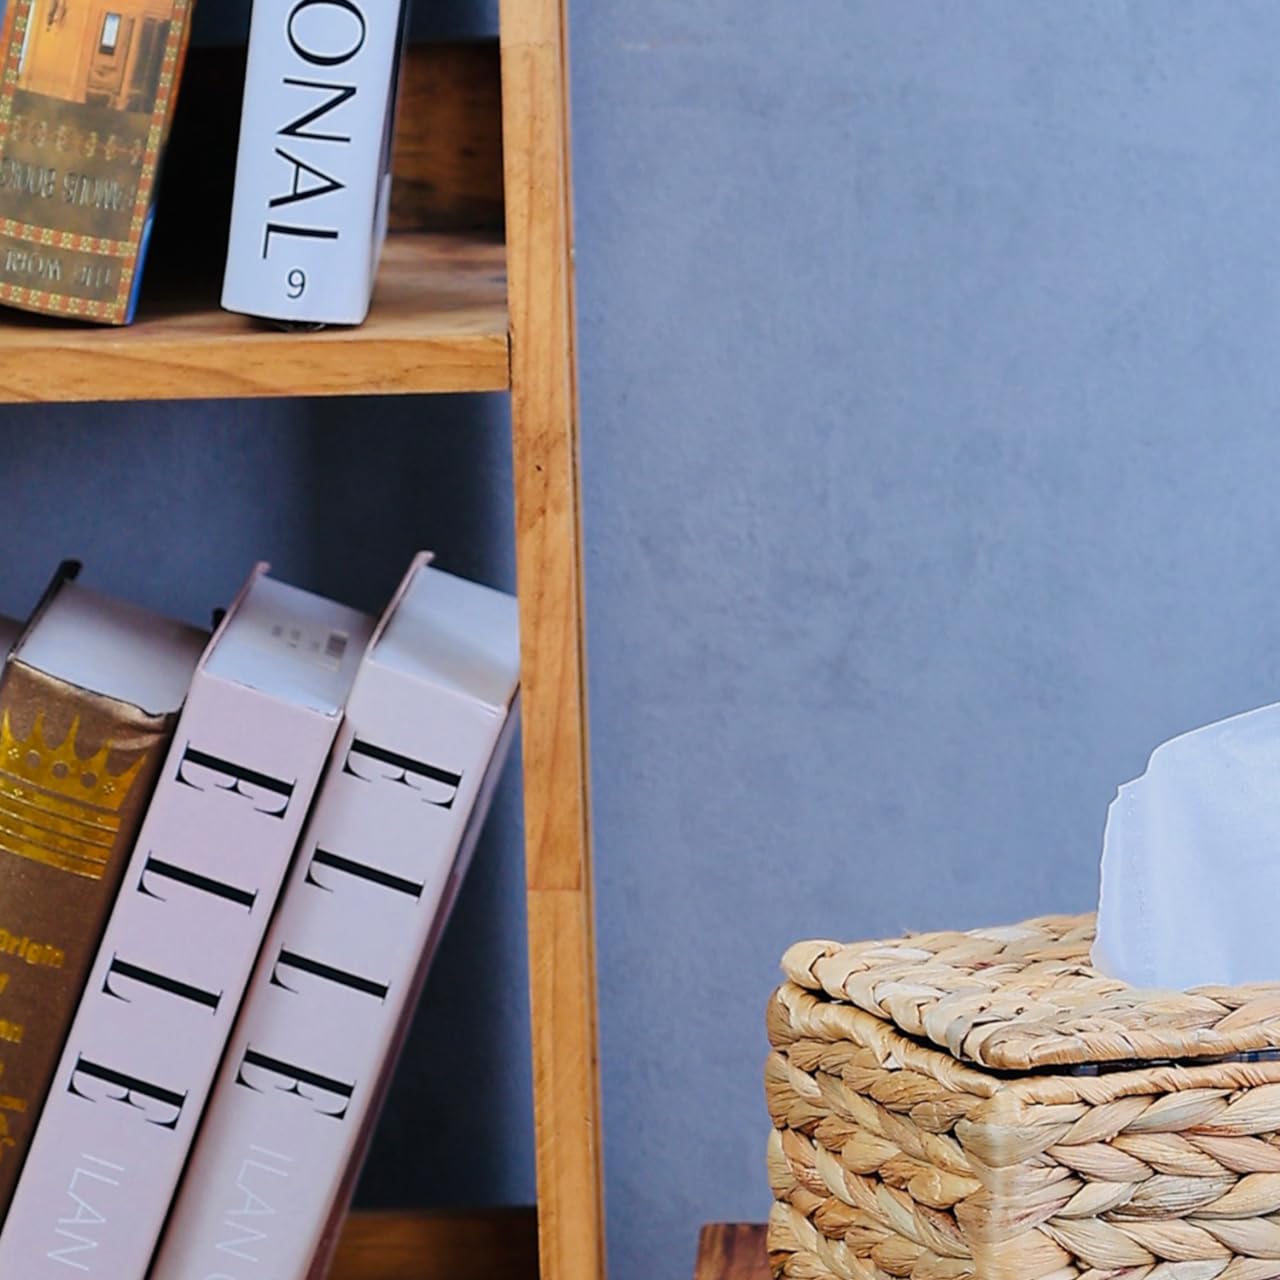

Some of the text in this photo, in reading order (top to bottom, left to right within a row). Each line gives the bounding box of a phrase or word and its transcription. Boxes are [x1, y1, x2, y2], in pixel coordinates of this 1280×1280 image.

[263, 0, 366, 260] ONAL
[286, 268, 306, 300] 9
[67, 740, 297, 1131] ELLE
[235, 731, 463, 1121] ELLE
[46, 1151, 126, 1273] ILAN
[215, 1143, 296, 1264] ILAN
